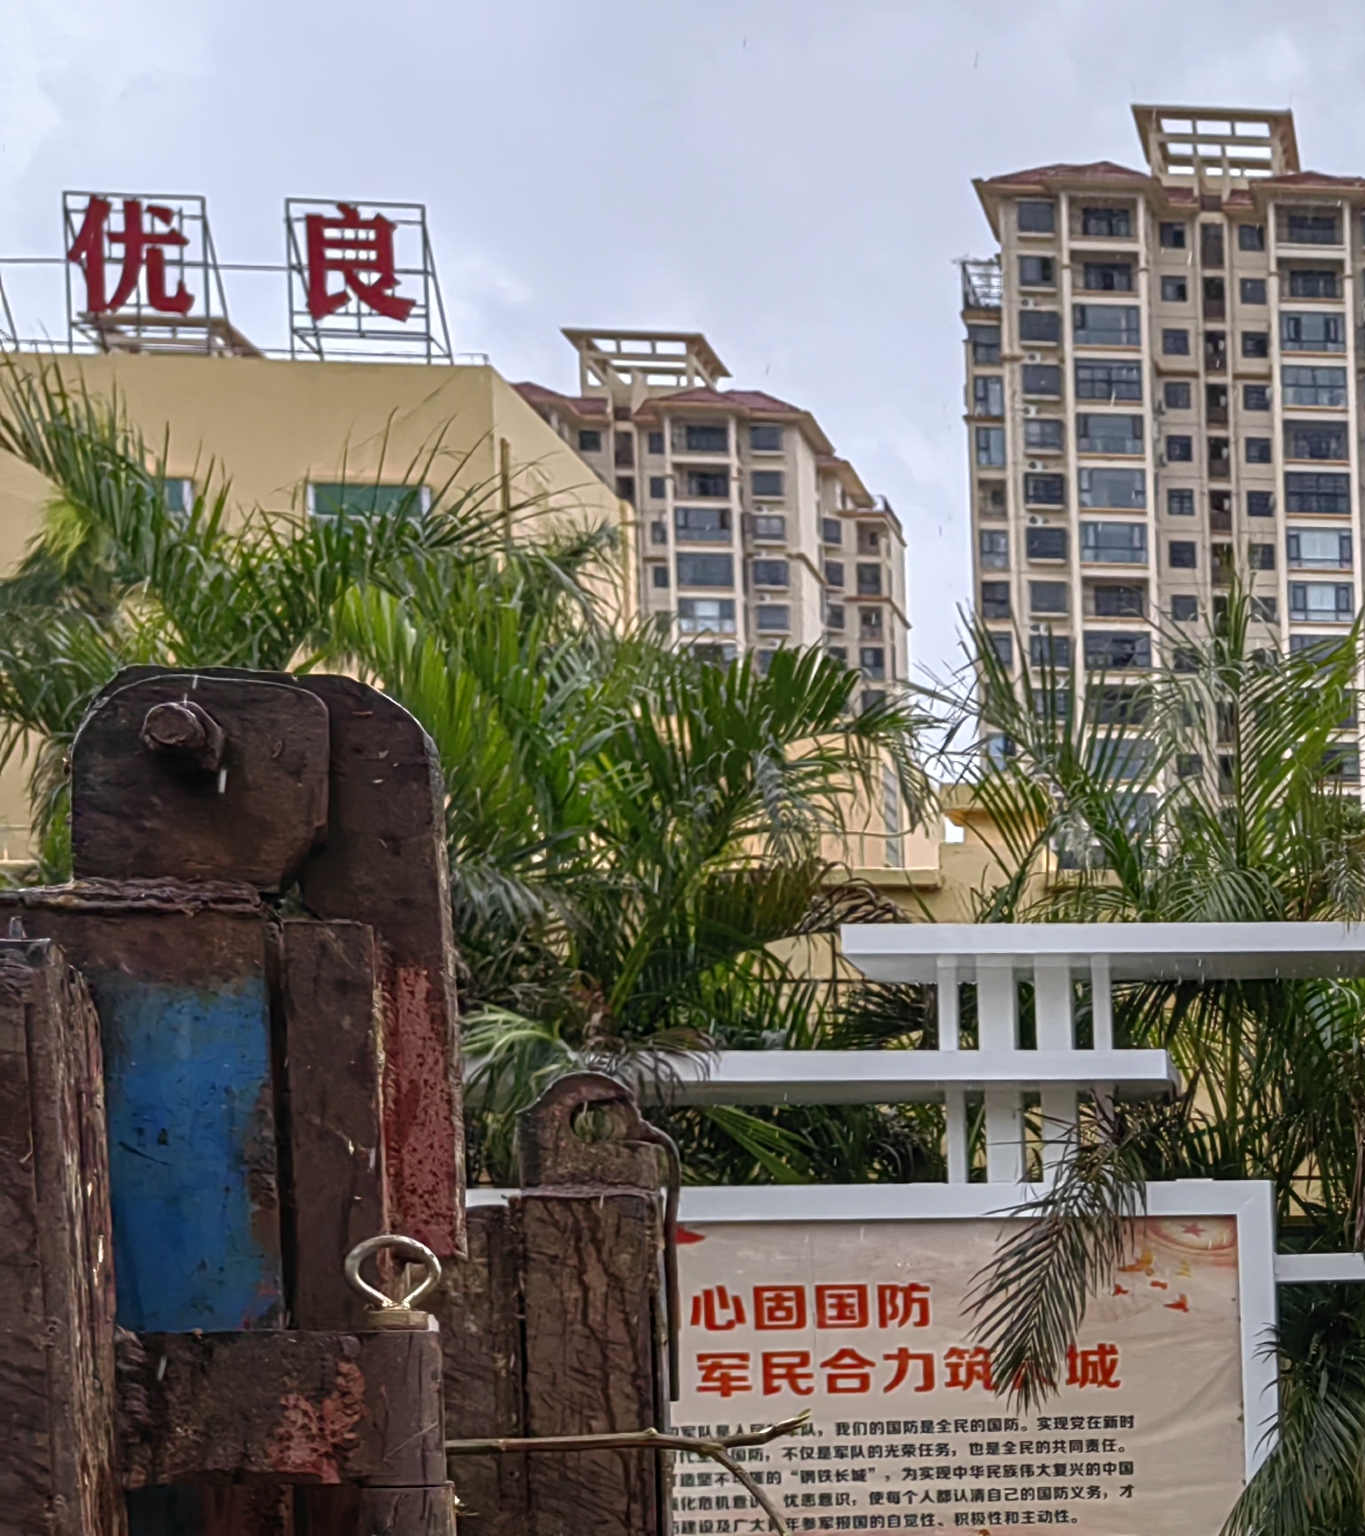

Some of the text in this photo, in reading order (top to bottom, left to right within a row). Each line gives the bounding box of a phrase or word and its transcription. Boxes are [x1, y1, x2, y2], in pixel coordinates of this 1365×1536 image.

[68, 195, 418, 323] 优良
[690, 1282, 931, 1331] 心固国防
[696, 1343, 1122, 1398] 军民合力筑城
